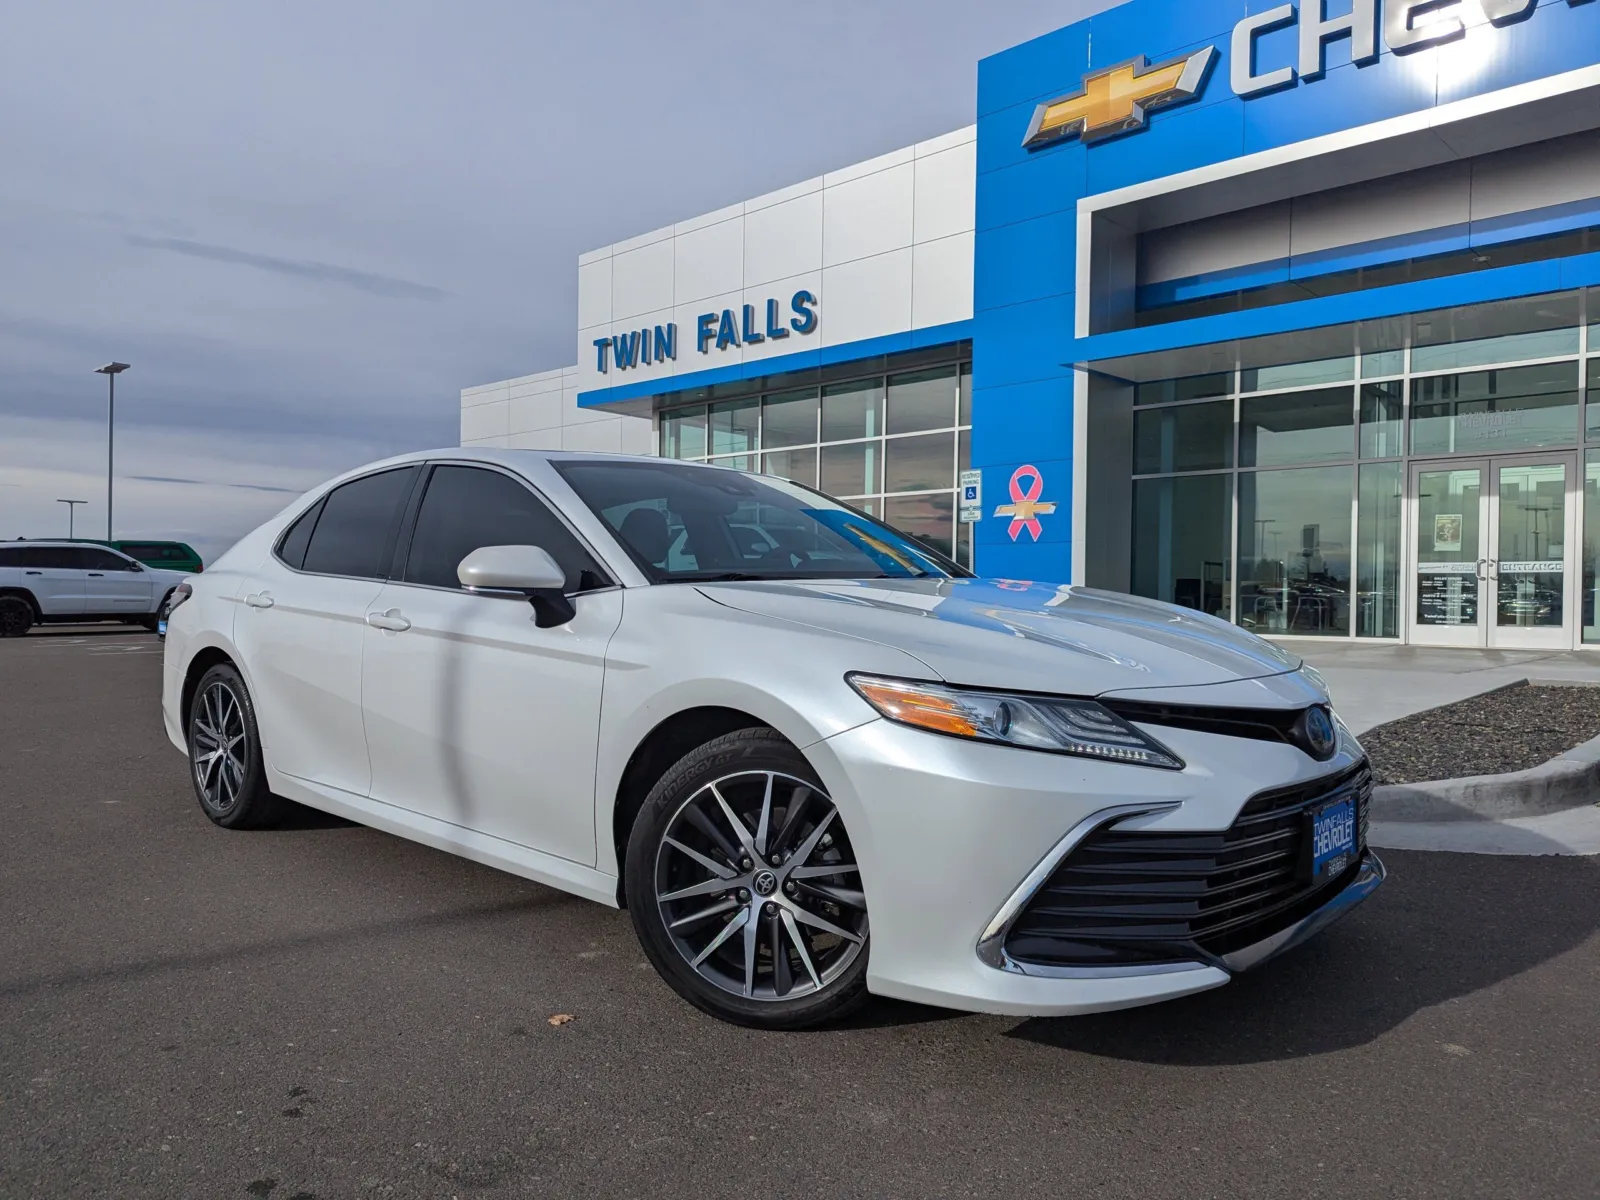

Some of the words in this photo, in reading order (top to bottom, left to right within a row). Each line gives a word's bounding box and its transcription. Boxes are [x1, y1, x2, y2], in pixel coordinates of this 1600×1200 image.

[1230, 0, 1597, 100] CHE
[593, 323, 677, 374] TWIN
[697, 290, 818, 355] FALLS
[1502, 563, 1562, 571] ENTRANCE
[657, 757, 714, 808] KINERGY
[1313, 820, 1353, 858] CHEVROLET
